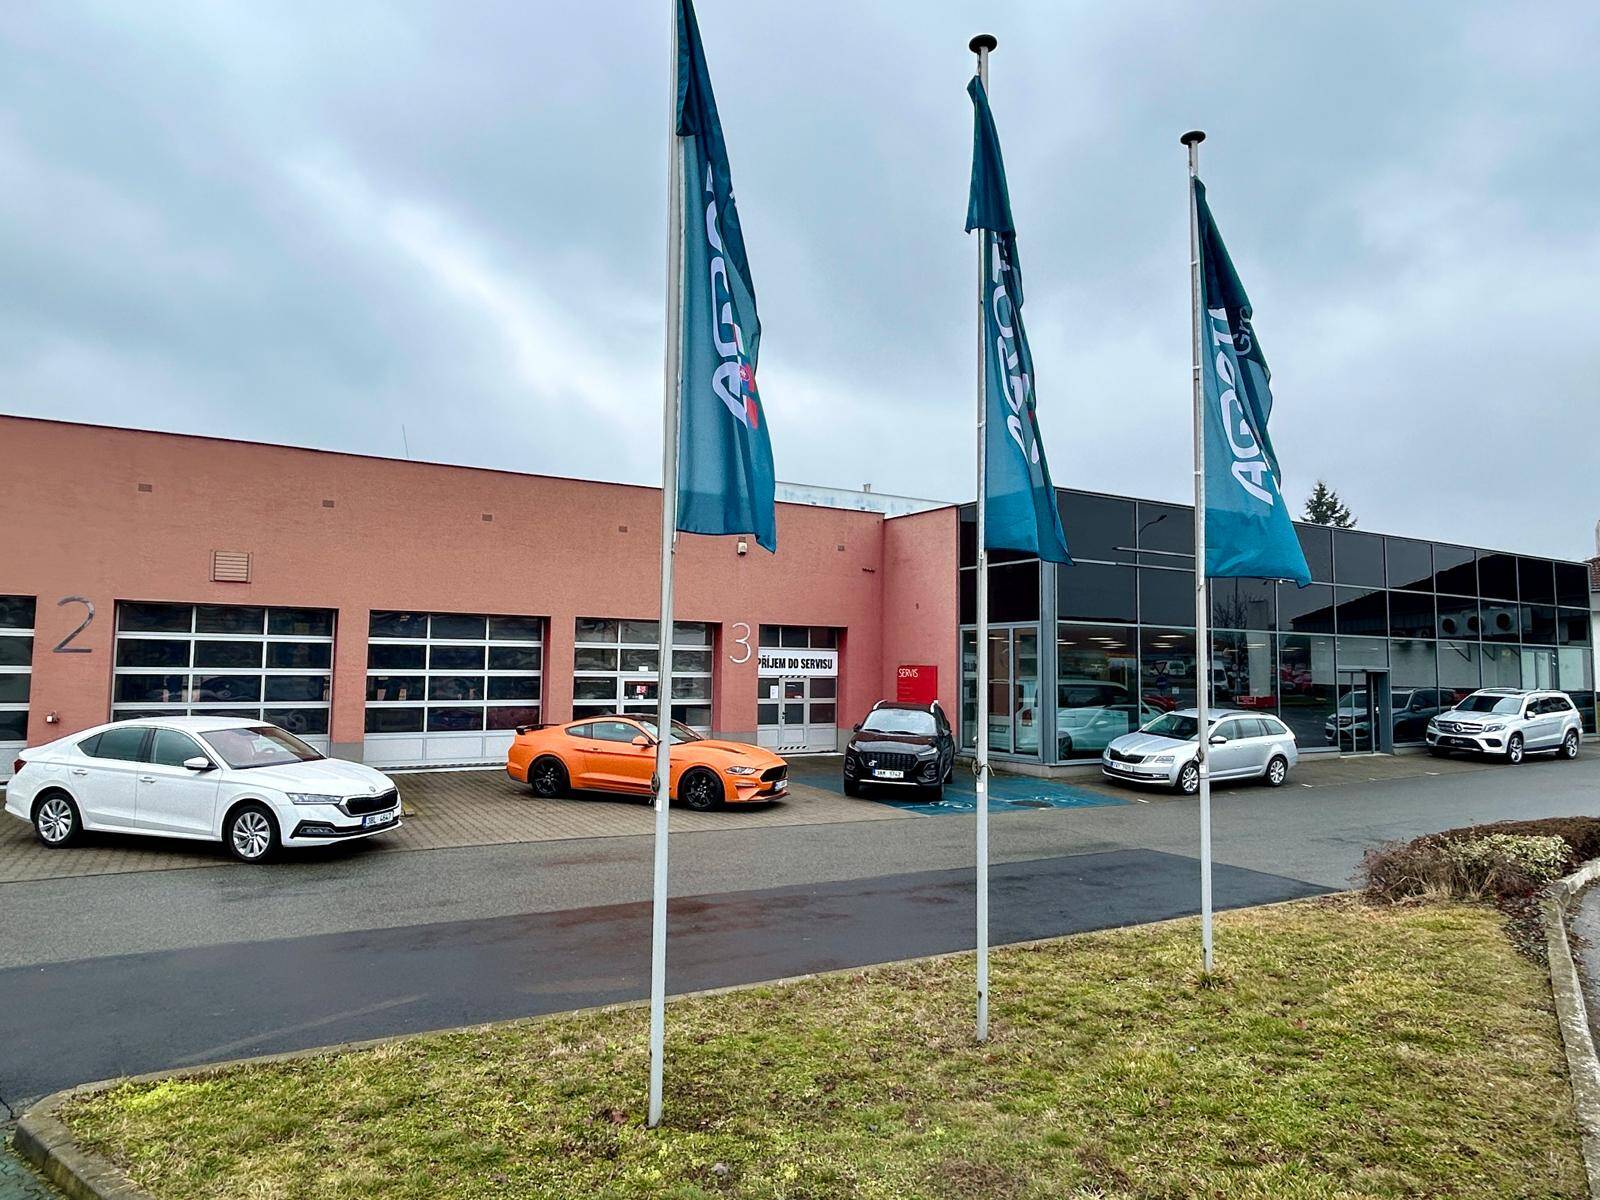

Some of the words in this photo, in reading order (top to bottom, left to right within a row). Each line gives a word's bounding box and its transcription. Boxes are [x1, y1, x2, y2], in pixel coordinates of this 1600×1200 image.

[52, 595, 96, 654] 2
[729, 622, 753, 664] 3
[788, 658, 799, 669] DO
[801, 658, 833, 669] SERVISU
[898, 668, 919, 678] SERVIS
